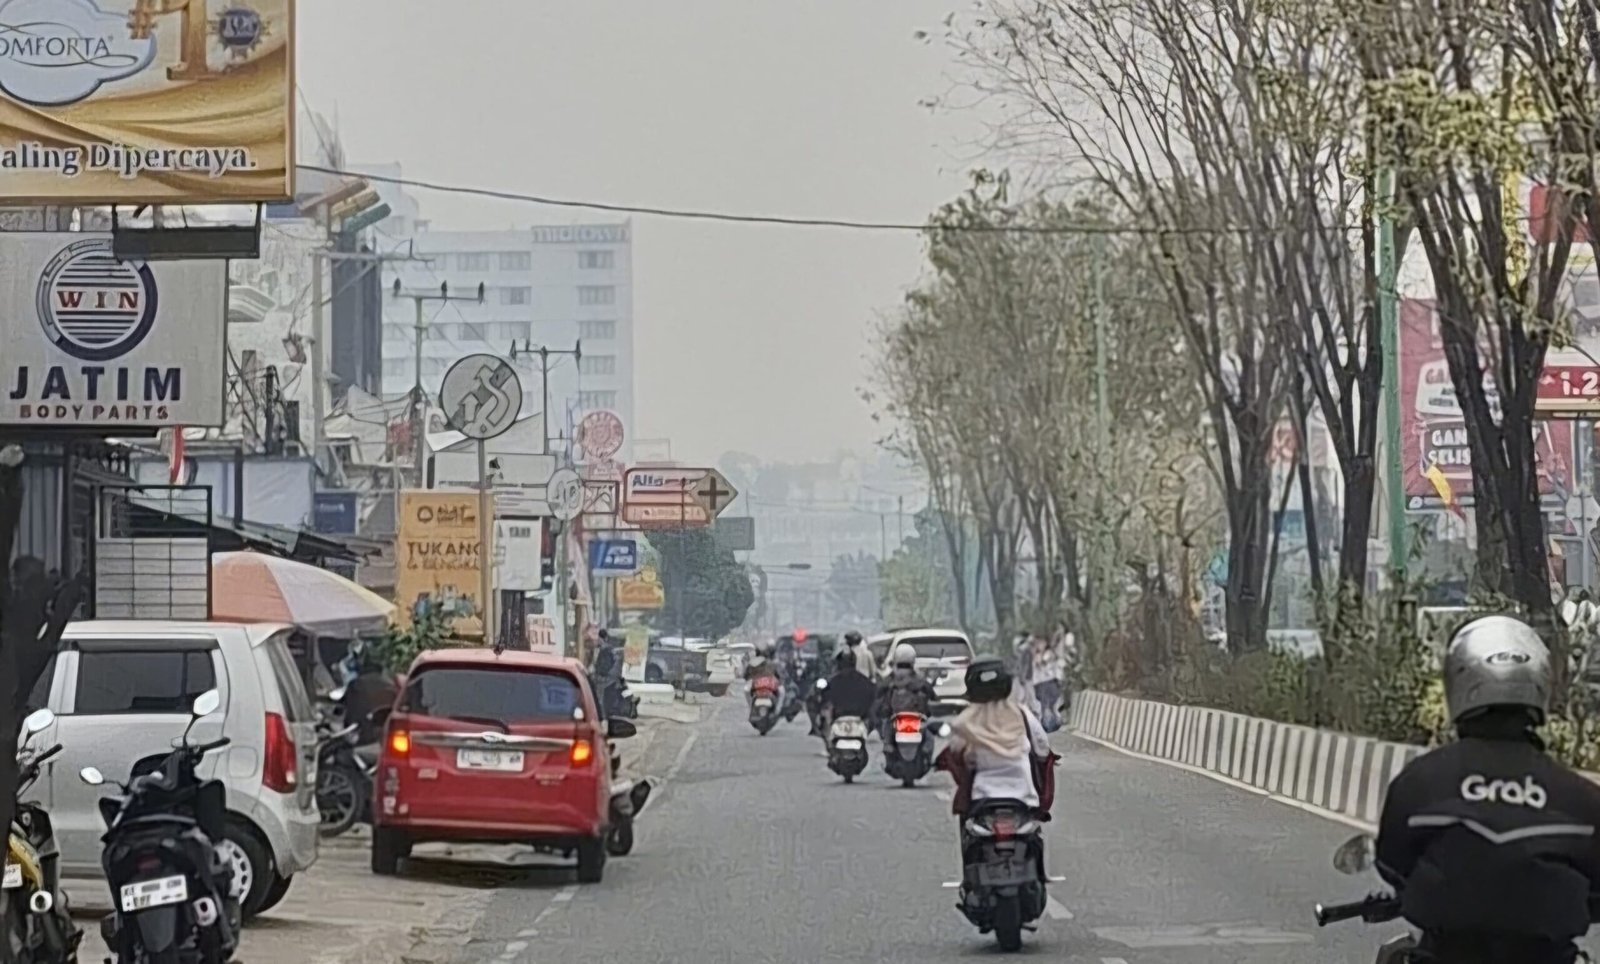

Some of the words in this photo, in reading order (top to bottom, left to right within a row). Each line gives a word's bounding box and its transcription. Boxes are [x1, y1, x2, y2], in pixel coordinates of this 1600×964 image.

[90, 143, 257, 176] Dipercaya.
[57, 290, 138, 309] WIN
[9, 366, 181, 401] JATIM
[19, 404, 83, 419] BODY
[92, 404, 169, 420] PARTS
[1431, 429, 1468, 447] GAN
[1428, 447, 1472, 466] SELIS
[1461, 774, 1547, 809] Grab
